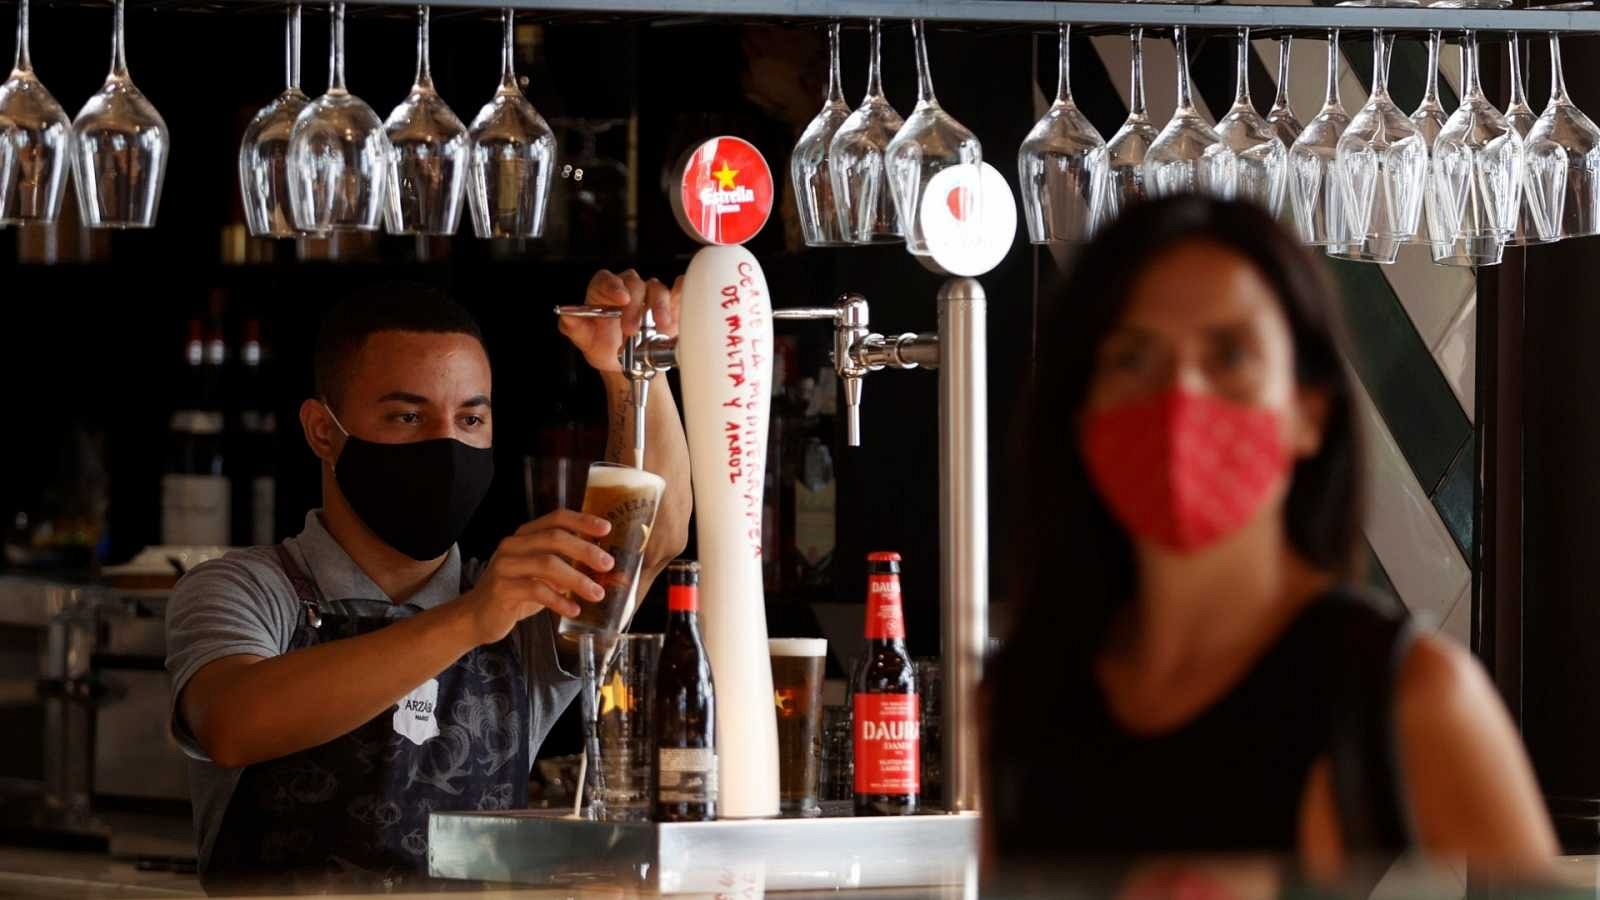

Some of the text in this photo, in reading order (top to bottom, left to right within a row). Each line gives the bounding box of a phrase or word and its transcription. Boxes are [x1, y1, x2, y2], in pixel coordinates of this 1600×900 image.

[701, 186, 755, 207] Estrella
[720, 285, 745, 484] DE MALTA Y ARROZ
